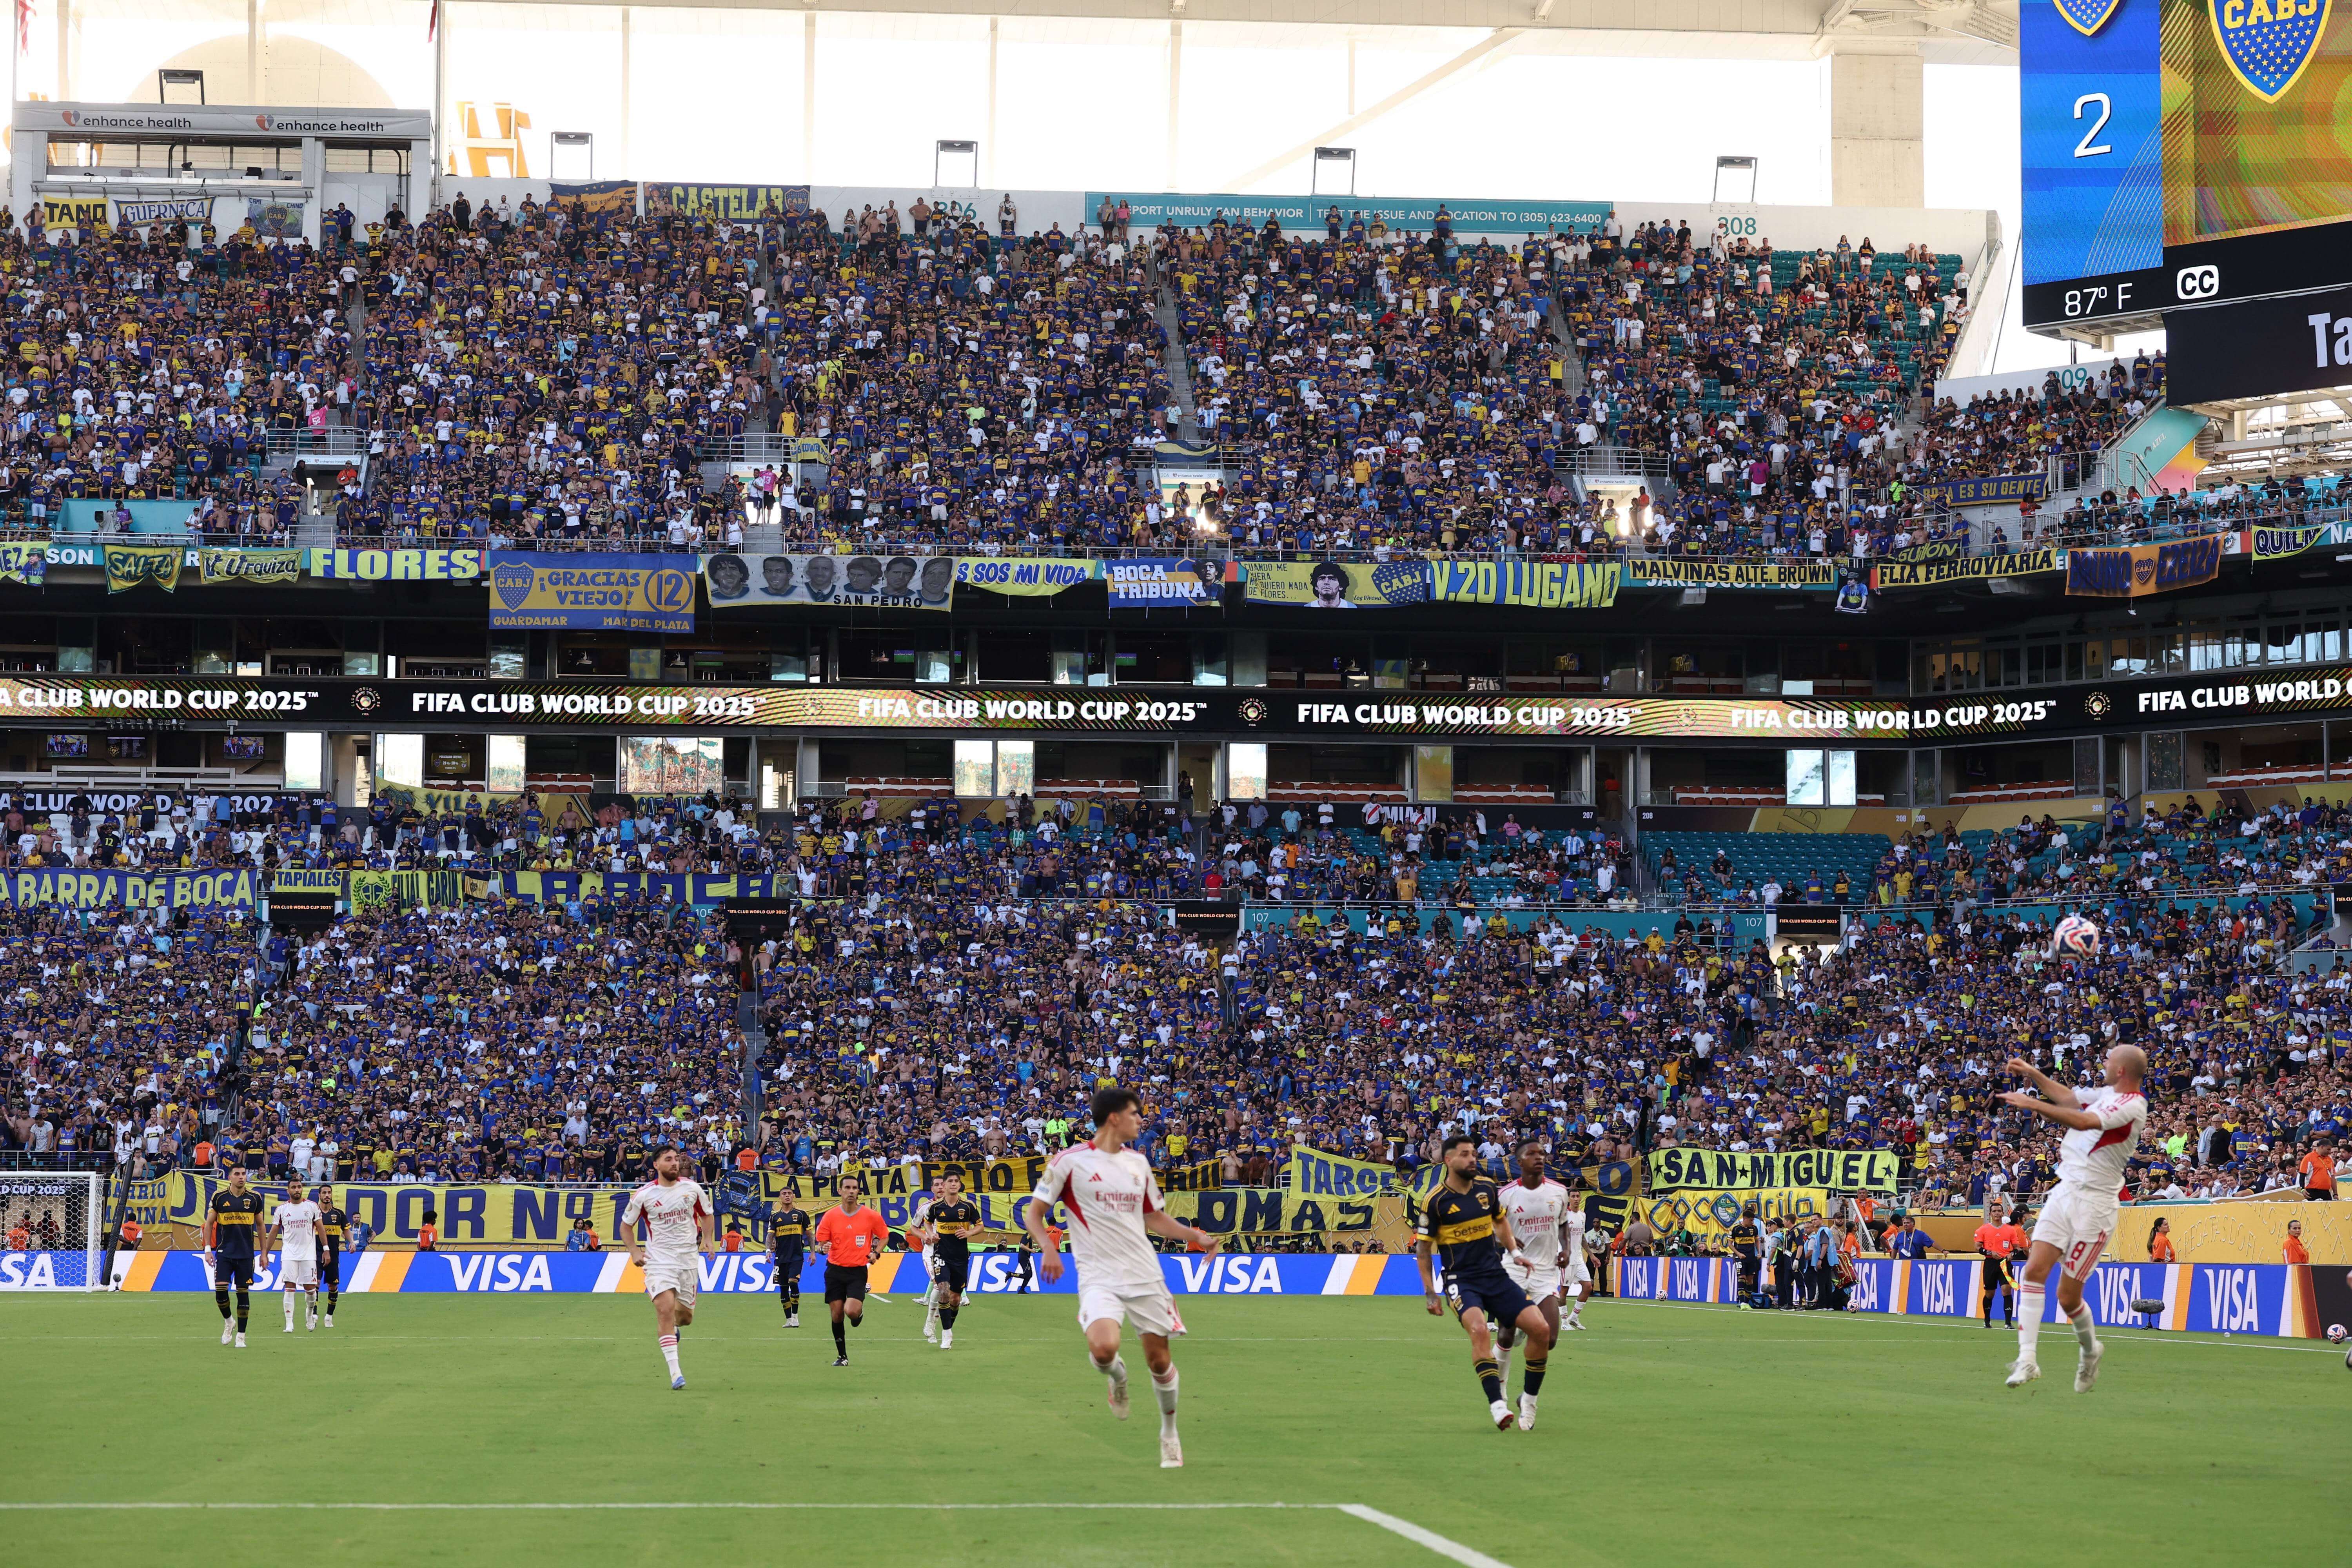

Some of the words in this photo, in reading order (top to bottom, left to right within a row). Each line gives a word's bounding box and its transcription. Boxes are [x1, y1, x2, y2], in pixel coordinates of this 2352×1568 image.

[83, 116, 143, 127] enhance
[148, 117, 191, 128] health
[277, 120, 337, 131] enhance
[341, 121, 384, 132] health
[2074, 92, 2112, 158] 2
[671, 187, 783, 220] CASTELAR
[788, 197, 806, 206] CABJ
[1166, 206, 1213, 216] UNRULY
[1216, 207, 1241, 217] FAN
[1243, 208, 1303, 218] BEHAVIOR
[44, 203, 106, 223] TANO
[1409, 211, 1435, 220] AND
[1501, 212, 1516, 221] TO
[1519, 212, 1548, 223] (305)
[1550, 212, 1601, 223] 623-6400
[2180, 270, 2215, 294] CC
[2118, 283, 2133, 309] F
[1960, 484, 1975, 498] ES
[1982, 482, 1997, 496] SU
[2000, 479, 2041, 496] GENTE
[109, 552, 174, 581] SALTA
[224, 554, 298, 577] Urquiza
[321, 550, 479, 580] FLORES
[1245, 563, 1272, 572] CUANDO
[1276, 563, 1288, 572] ME
[1880, 564, 1920, 584] FLIA
[1925, 550, 2053, 579] FERROVIARIA
[2069, 551, 2131, 588] BRUNO
[2156, 536, 2222, 585] EZEIZA
[497, 578, 531, 588] CABJ
[538, 571, 641, 593] ¡GRACIAS
[973, 563, 1011, 583] SOS
[1013, 563, 1040, 585] MI
[1044, 564, 1089, 586] VIDA
[1112, 564, 1167, 581] BOCA
[1380, 571, 1421, 594] CABJ
[1632, 561, 1730, 582] MALVINAS
[1735, 565, 1773, 583] ALTE.
[1778, 565, 1832, 582] BROWN
[656, 573, 682, 607] 12
[1114, 581, 1207, 599] TRIBUNA
[1248, 586, 1257, 596] DE
[1260, 580, 1285, 590] QUIERO
[1289, 582, 1308, 591] NADA
[1504, 561, 1622, 608] LUGANO
[556, 590, 634, 606] VIEJO!
[833, 595, 862, 605] SAN
[871, 595, 923, 608] PEDRO
[493, 615, 567, 626] GUARDAMAR
[603, 616, 628, 627] MAR
[630, 618, 651, 628] DEL
[654, 619, 690, 630] PLATA
[18, 688, 83, 707] CLUB
[89, 689, 182, 709] WORLD
[188, 690, 239, 710] CUP
[244, 691, 319, 710] 2025™
[412, 693, 466, 712] FIFA
[471, 693, 535, 713] CLUB
[541, 694, 632, 714] WORLD
[637, 695, 688, 715] CUP
[2138, 690, 2187, 712] FIFA
[2191, 686, 2250, 709] CLUB
[2254, 679, 2341, 703] WORLD
[858, 699, 911, 718] FIFA
[916, 699, 980, 719] CLUB
[985, 700, 1075, 720] WORLD
[1080, 701, 1130, 720] CUP
[1135, 702, 1207, 721] 2025™
[1298, 704, 1350, 723] FIFA
[1355, 704, 1417, 724] CLUB
[1422, 706, 1512, 725] WORLD
[1516, 706, 1566, 726] CUP
[1731, 709, 1783, 728] FIFA
[1788, 710, 1849, 729] CLUB
[1855, 710, 1941, 730] WORLD
[1945, 706, 1988, 726] CUP
[1993, 700, 2056, 723] 2025™
[105, 838, 113, 847] 12
[276, 871, 341, 887] TAPIALES
[18, 873, 118, 909] BARRA
[126, 876, 167, 911] DE
[173, 873, 253, 911] BOCA
[1252, 912, 1269, 922] 107
[1745, 918, 1762, 927] 107
[1664, 1149, 1737, 1187] SAN
[1750, 1149, 1884, 1187] MIGUEL
[13, 1185, 35, 1194] CUP
[762, 1172, 802, 1198] LA
[812, 1168, 907, 1198] PLATA
[1095, 1191, 1143, 1203] Emirates
[1518, 1215, 1555, 1227] Emirates
[2071, 1240, 2087, 1261] 8
[439, 1254, 553, 1291] VISA
[1170, 1256, 1282, 1293] VISA
[1626, 1259, 1648, 1297] VISA
[1675, 1260, 1698, 1299] VISA
[1448, 1284, 1459, 1300] 9
[1918, 1263, 1954, 1314] VISA
[2095, 1267, 2142, 1325] VISA
[2204, 1268, 2259, 1332] VISA
